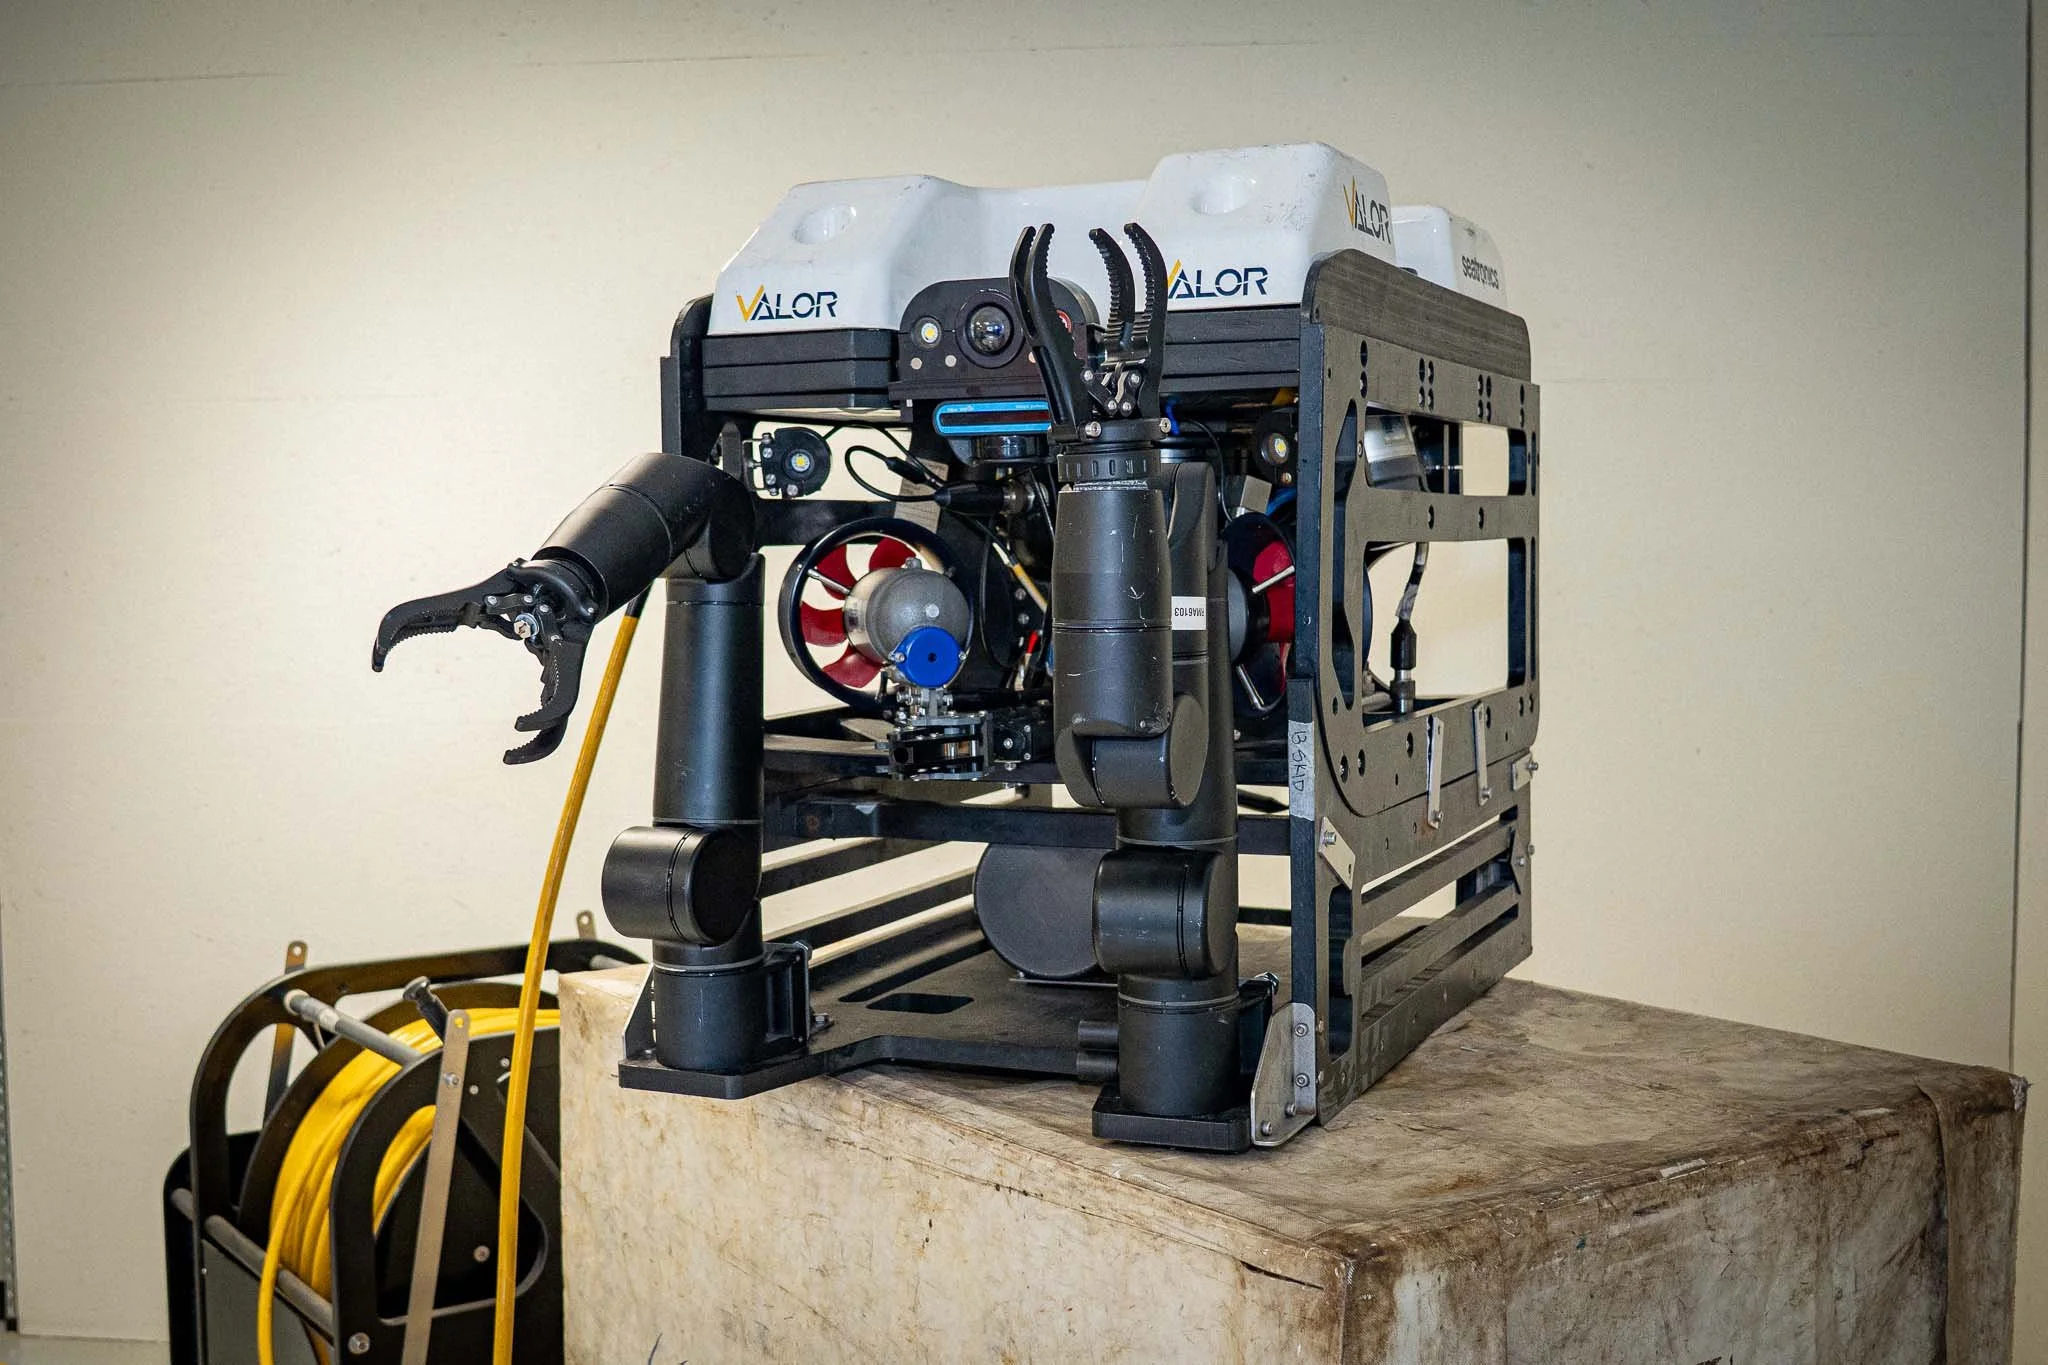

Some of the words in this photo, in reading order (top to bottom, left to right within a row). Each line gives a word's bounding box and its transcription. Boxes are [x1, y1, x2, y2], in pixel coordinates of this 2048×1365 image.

[1343, 175, 1391, 245] VALOR
[1461, 255, 1499, 290] seatronics
[736, 284, 839, 321] VALOR
[1174, 607, 1205, 617] RMA6103
